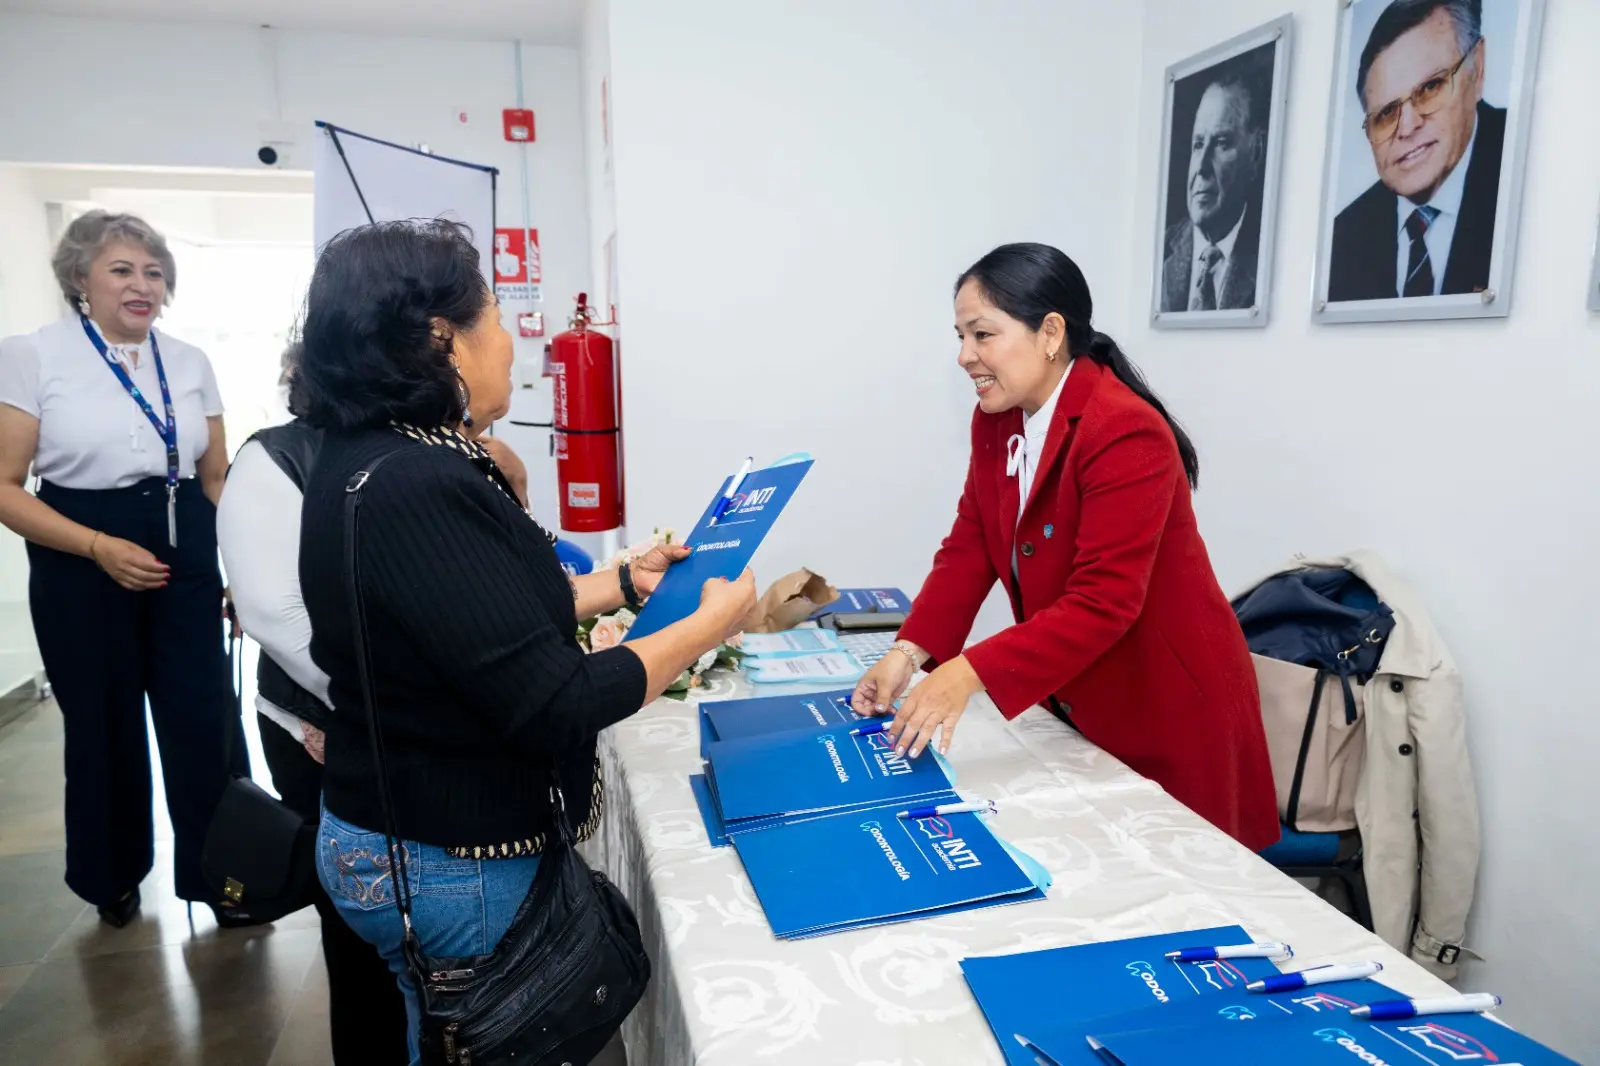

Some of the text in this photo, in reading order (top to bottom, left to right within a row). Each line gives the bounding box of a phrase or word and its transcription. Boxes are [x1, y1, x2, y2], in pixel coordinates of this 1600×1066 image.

[743, 486, 777, 506] INTI
[824, 739, 850, 783] ODONTOLOGÍA
[882, 751, 913, 776] INTI
[869, 827, 911, 881] ODONTOLOGÍA
[931, 842, 956, 871] academia
[941, 838, 982, 869] INTI
